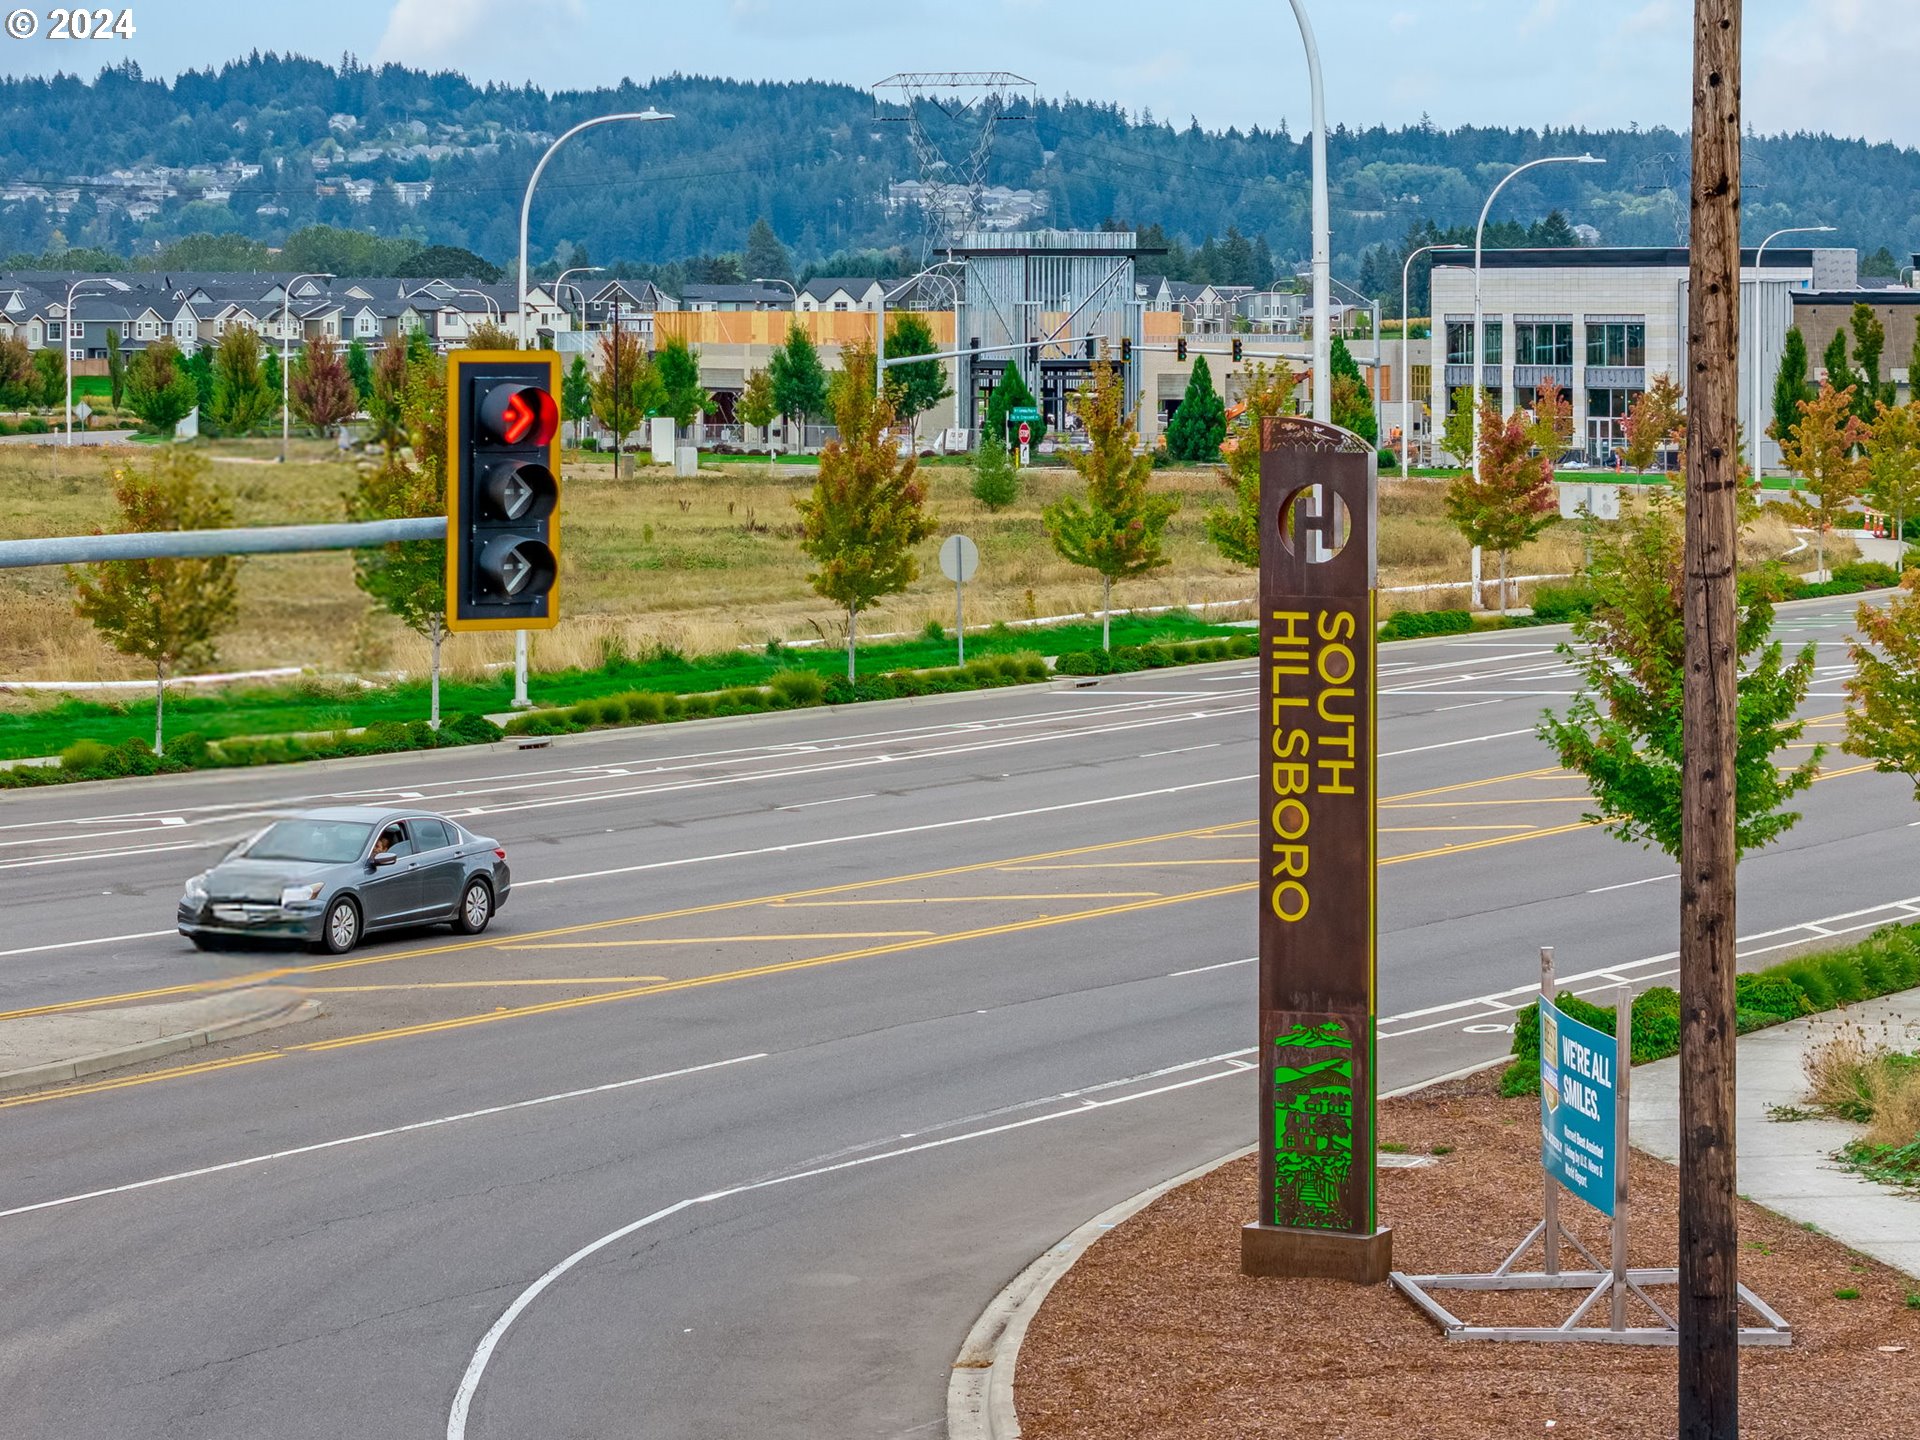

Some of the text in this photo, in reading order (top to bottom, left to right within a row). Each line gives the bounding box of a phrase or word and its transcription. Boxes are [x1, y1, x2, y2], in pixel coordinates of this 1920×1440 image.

[1317, 609, 1355, 794] SOUTH
[1272, 610, 1310, 922] HILLSBORO
[1562, 1035, 1590, 1078] WE'RE
[1592, 1052, 1612, 1089] ALL
[1563, 1074, 1600, 1122] SMILES.
